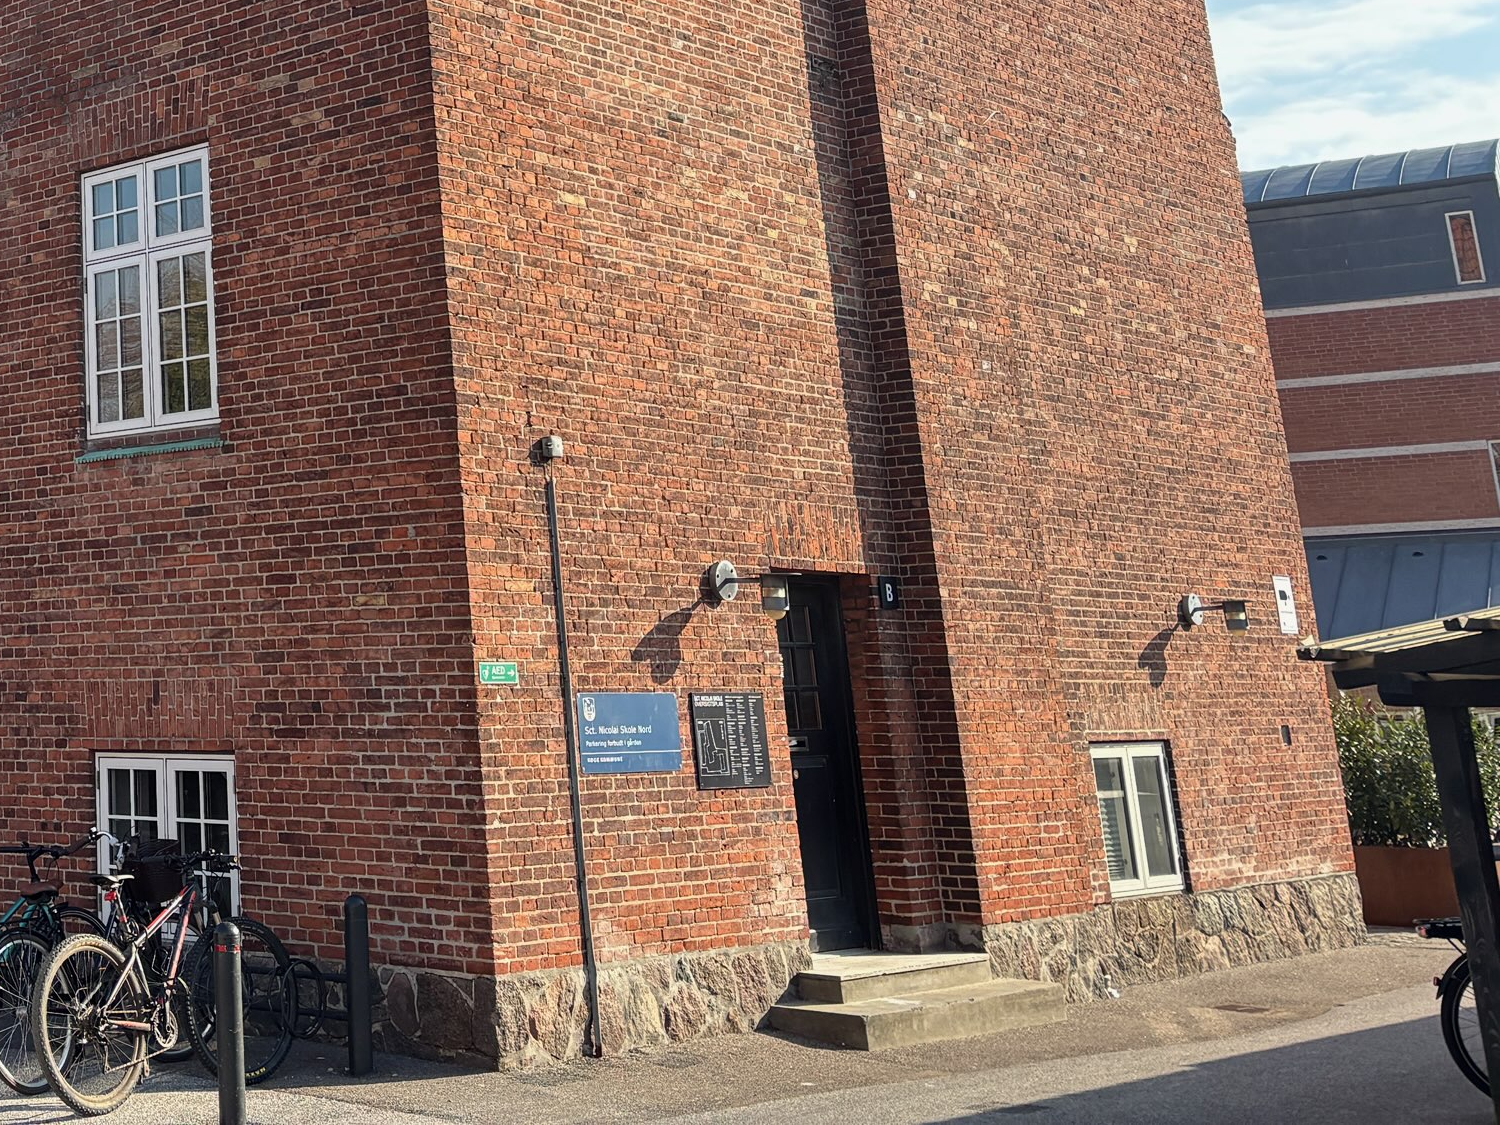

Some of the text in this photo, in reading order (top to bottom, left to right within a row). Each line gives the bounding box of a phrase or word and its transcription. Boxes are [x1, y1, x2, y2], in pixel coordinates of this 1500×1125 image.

[885, 583, 893, 601] B
[492, 666, 505, 675] AED
[585, 725, 652, 735] Sct. Nicolai Skole Nord
[586, 740, 606, 748] Parkering
[627, 738, 642, 747] gården
